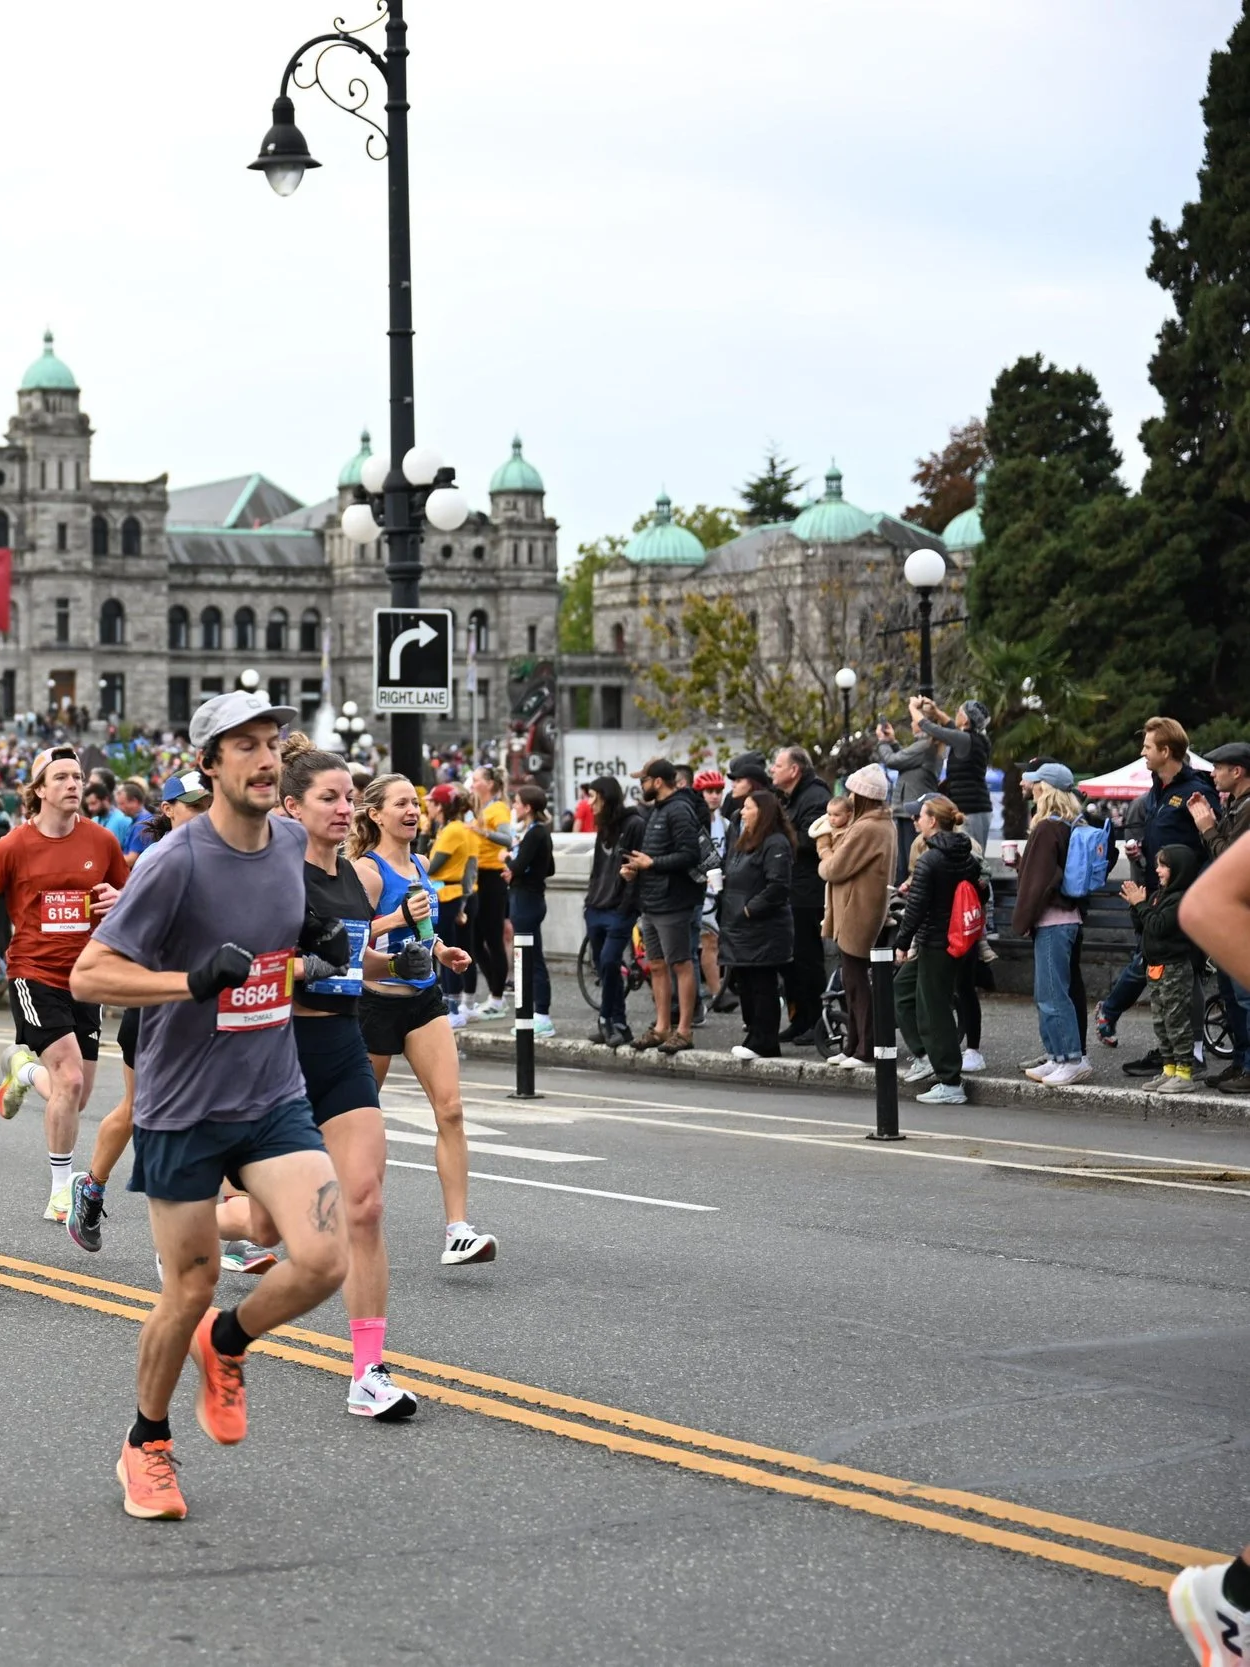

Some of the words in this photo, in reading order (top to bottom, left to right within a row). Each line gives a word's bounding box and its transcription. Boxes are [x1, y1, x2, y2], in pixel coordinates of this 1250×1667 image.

[380, 691, 414, 704] RIGHT
[416, 691, 445, 705] LANE
[573, 755, 627, 777] Fresh
[45, 894, 66, 904] RVM
[48, 907, 80, 920] 6154
[231, 981, 279, 1007] 6684
[243, 1012, 274, 1023] THOMAS
